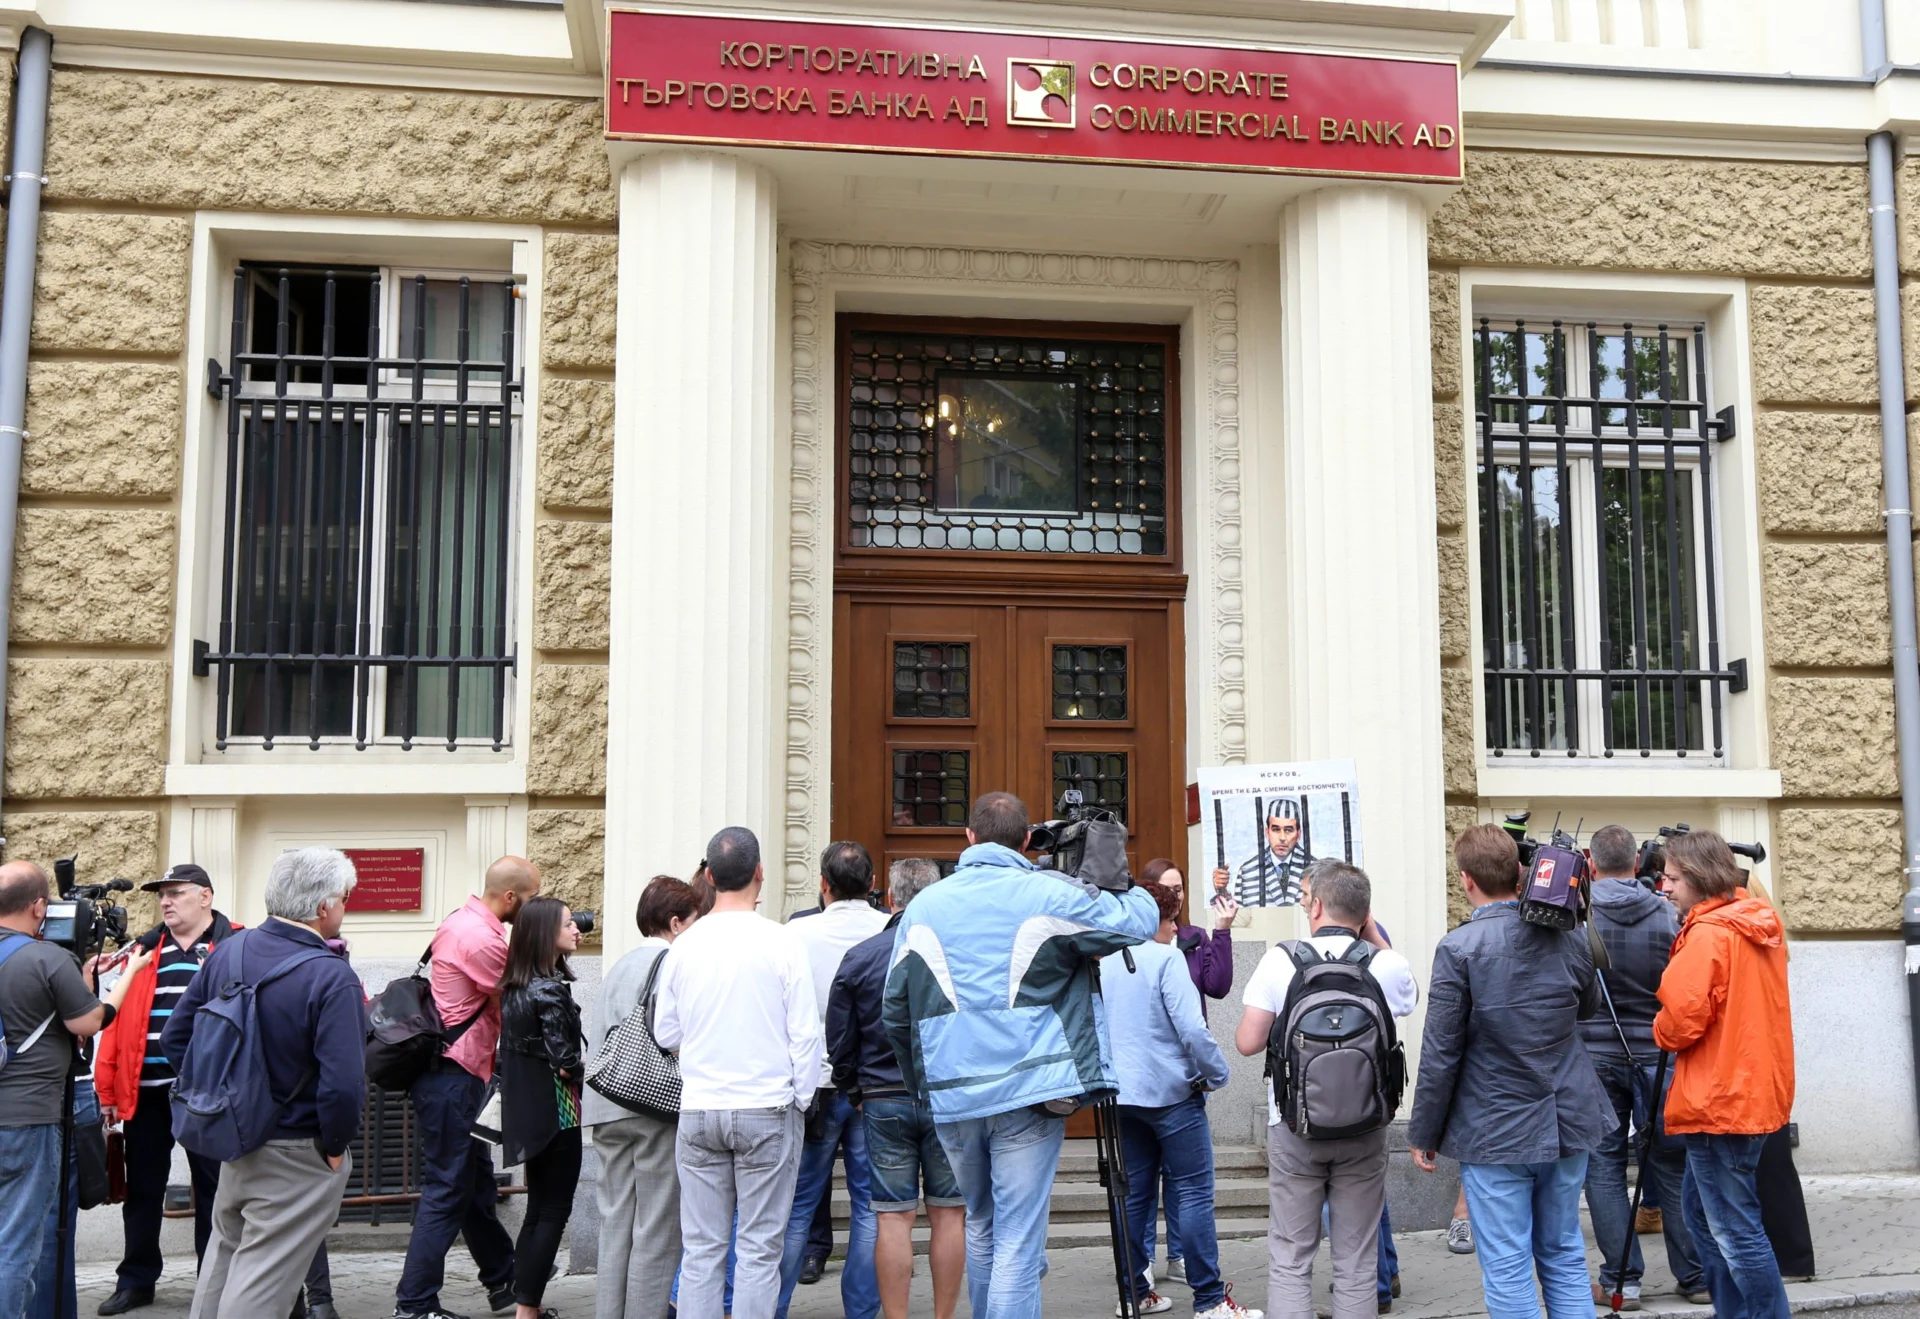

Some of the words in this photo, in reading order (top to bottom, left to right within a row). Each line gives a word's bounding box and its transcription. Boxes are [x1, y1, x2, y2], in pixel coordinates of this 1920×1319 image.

[719, 40, 987, 80] КОРПОРАТИВНА
[1089, 61, 1289, 98] CORPORATE
[616, 77, 817, 114] ТЪРГОВСКА
[828, 89, 935, 120] БАНКА
[943, 96, 989, 128] АД
[1090, 104, 1310, 141] COMMERCIAL
[1319, 116, 1405, 146] BANK
[1413, 122, 1456, 149] AD
[1212, 788, 1233, 796] ВРЕМЕ
[1297, 783, 1347, 791] КОСТЮМЧЕТО!
